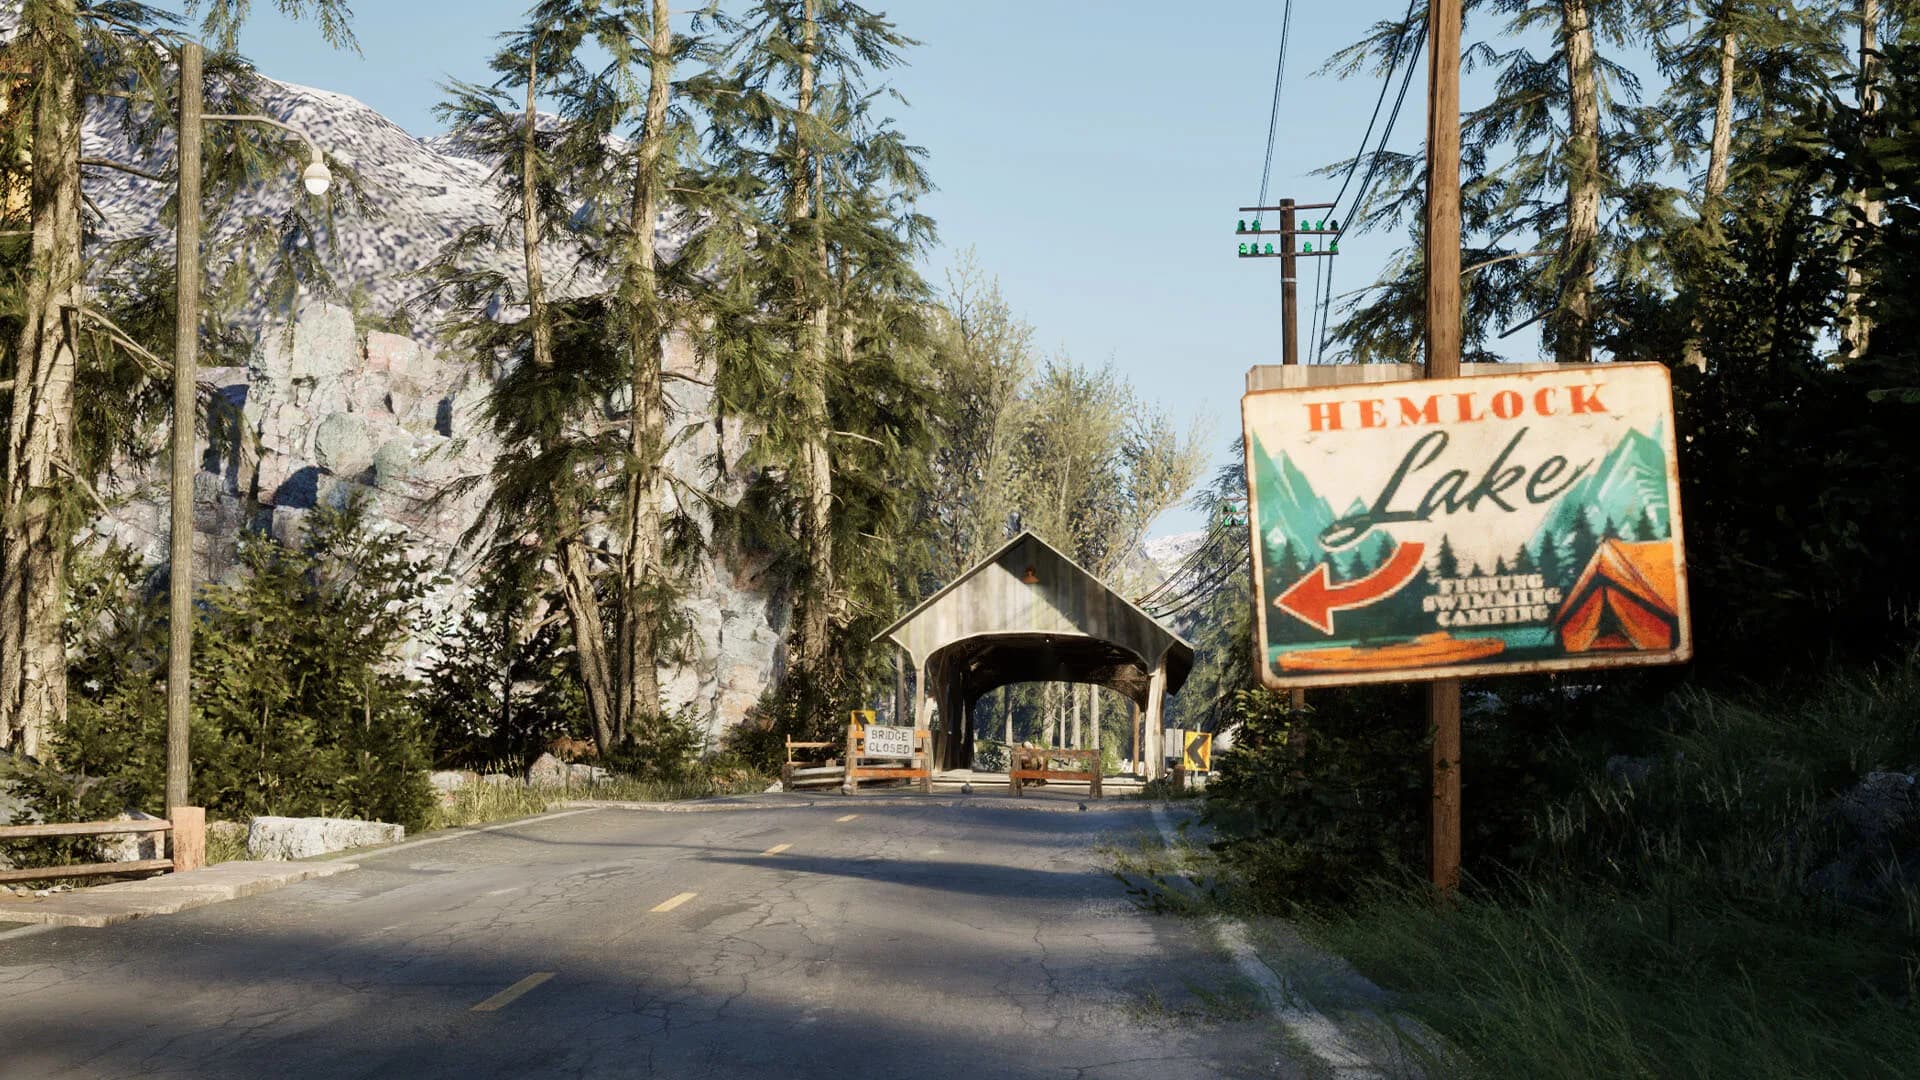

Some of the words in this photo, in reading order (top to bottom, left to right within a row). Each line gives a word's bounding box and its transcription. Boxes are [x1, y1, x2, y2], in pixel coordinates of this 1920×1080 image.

[1304, 384, 1608, 432] HEMLOCK
[1319, 426, 1594, 551] Lake
[1438, 573, 1544, 595] FISHING
[1422, 587, 1562, 612] SWIMMING
[1436, 605, 1550, 627] CAMPING
[871, 729, 908, 741] BRIDGE
[869, 742, 910, 754] CLOSED
